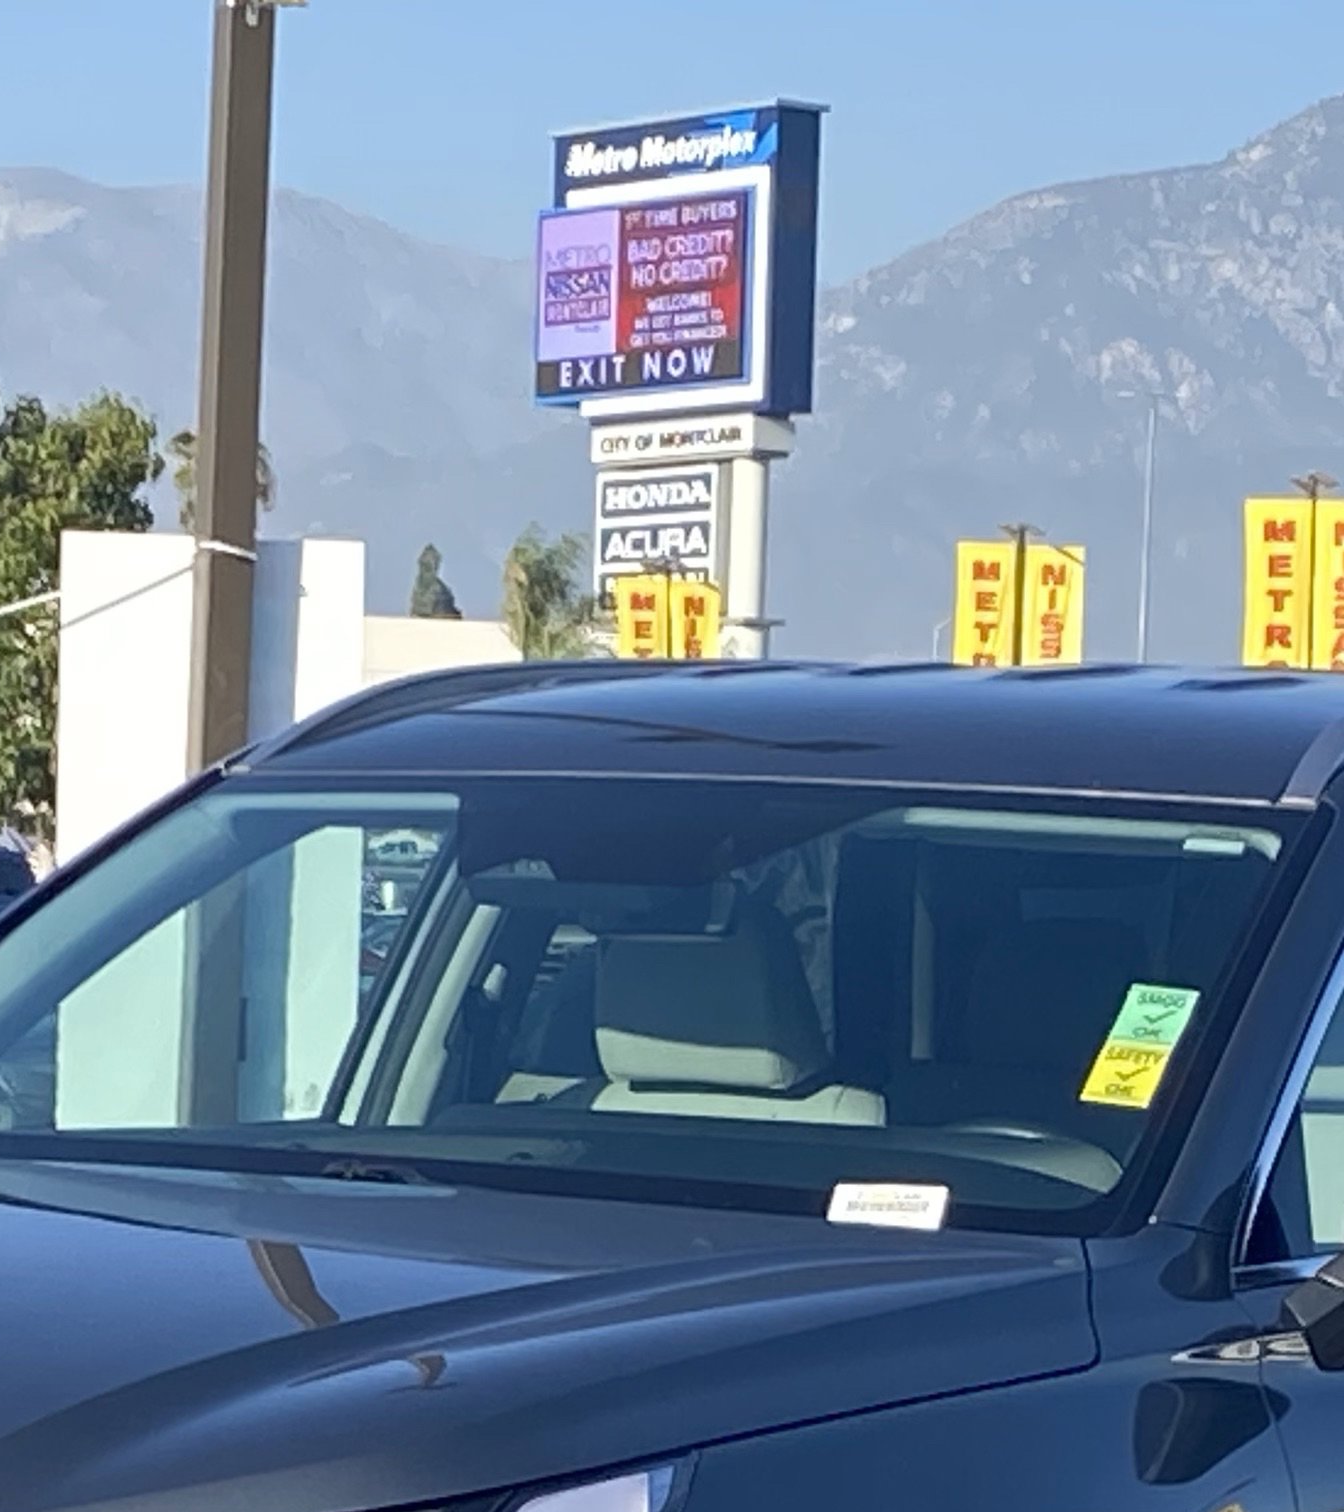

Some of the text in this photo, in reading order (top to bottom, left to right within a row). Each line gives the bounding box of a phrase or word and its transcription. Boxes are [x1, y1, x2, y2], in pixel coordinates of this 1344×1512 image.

[566, 126, 755, 176] Metro Motorplex
[631, 263, 656, 288] NO
[560, 346, 714, 387] EXIT NOW
[601, 426, 742, 453] CITY OF MONTCLAIR
[606, 480, 710, 509] HONDA
[606, 527, 705, 560] ACURA
[1040, 564, 1066, 659] NISS
[1264, 519, 1296, 668] METR
